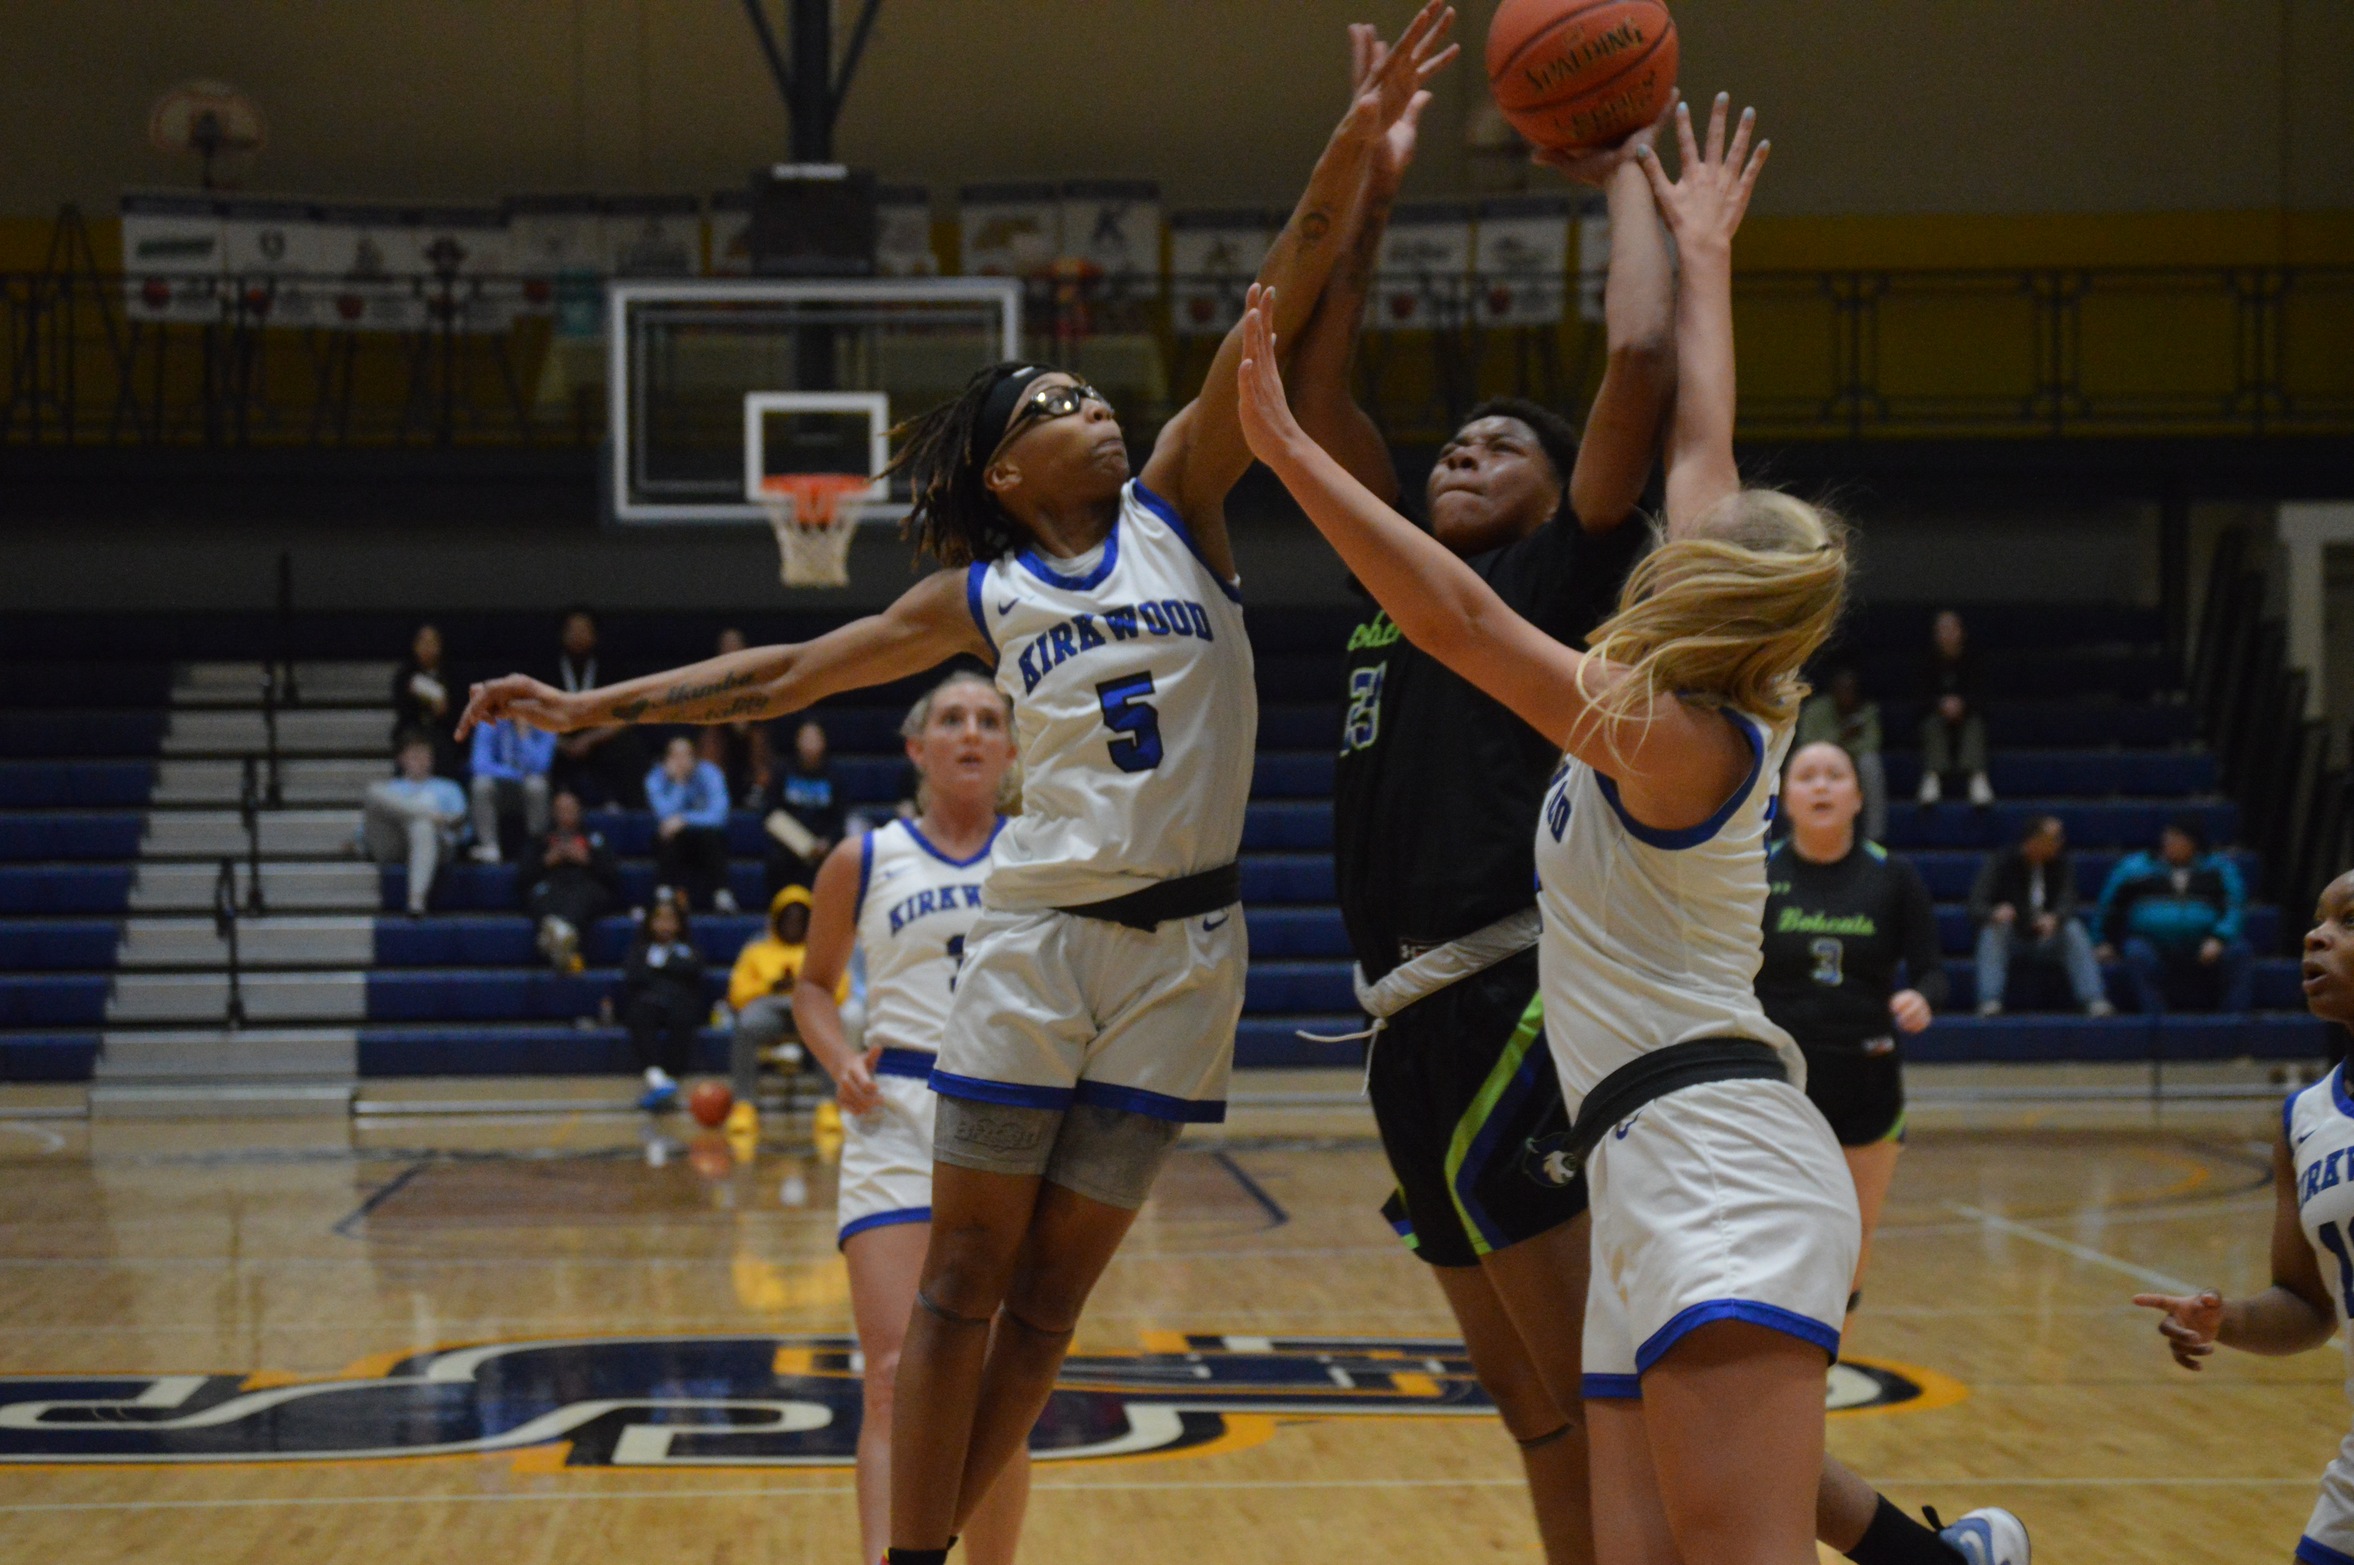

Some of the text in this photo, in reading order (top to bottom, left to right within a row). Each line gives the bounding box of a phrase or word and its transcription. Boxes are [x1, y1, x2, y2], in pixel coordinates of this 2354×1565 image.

[1524, 17, 1644, 92] SPALDING
[1018, 600, 1214, 696] KIRKWOOD
[1096, 670, 1164, 773] 5
[889, 884, 983, 937] KIRKW
[1776, 905, 1876, 937] Bobcats
[1809, 936, 1844, 986] 3
